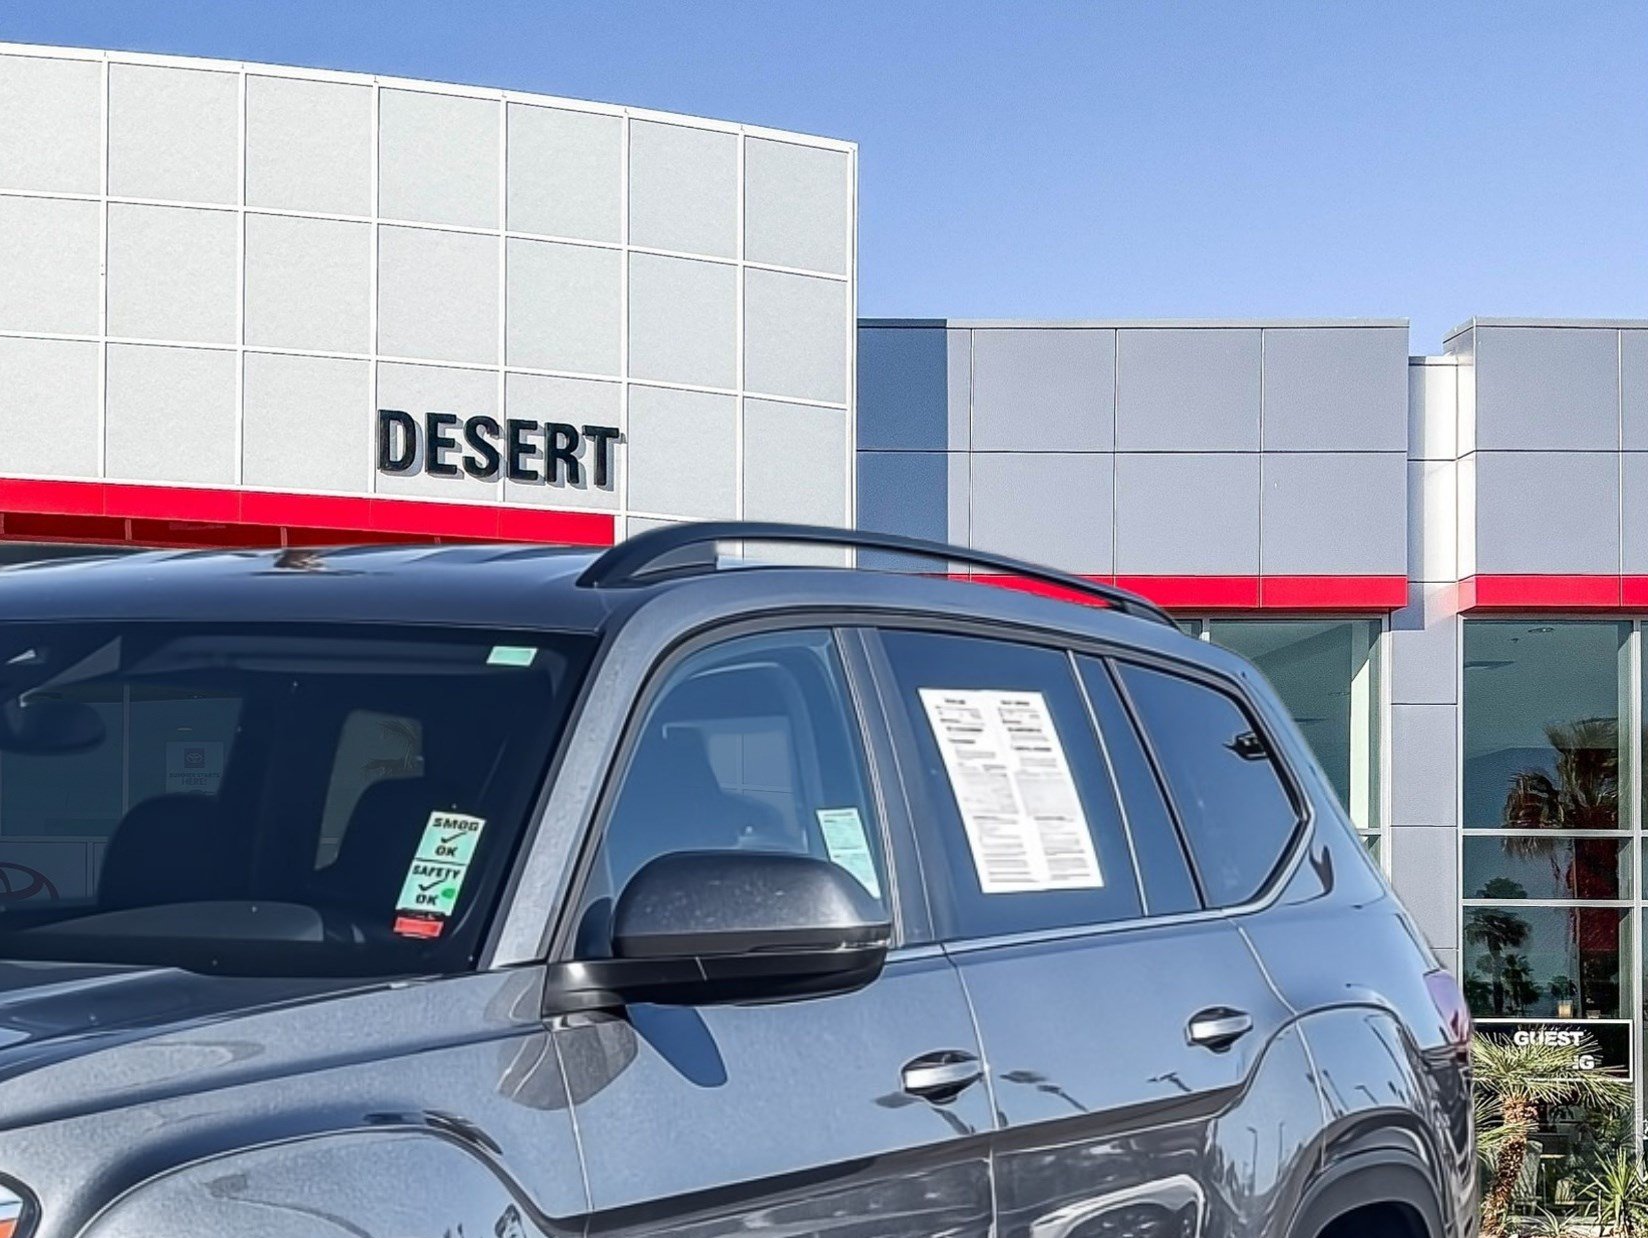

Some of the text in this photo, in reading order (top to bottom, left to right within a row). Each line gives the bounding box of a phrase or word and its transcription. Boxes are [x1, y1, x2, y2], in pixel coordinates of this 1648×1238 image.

[377, 409, 620, 486] DESERT
[432, 817, 479, 832] SMOG
[435, 846, 458, 857] OK
[412, 865, 461, 880] SAFETY
[415, 894, 438, 906] OK
[1513, 1030, 1585, 1048] GUEST
